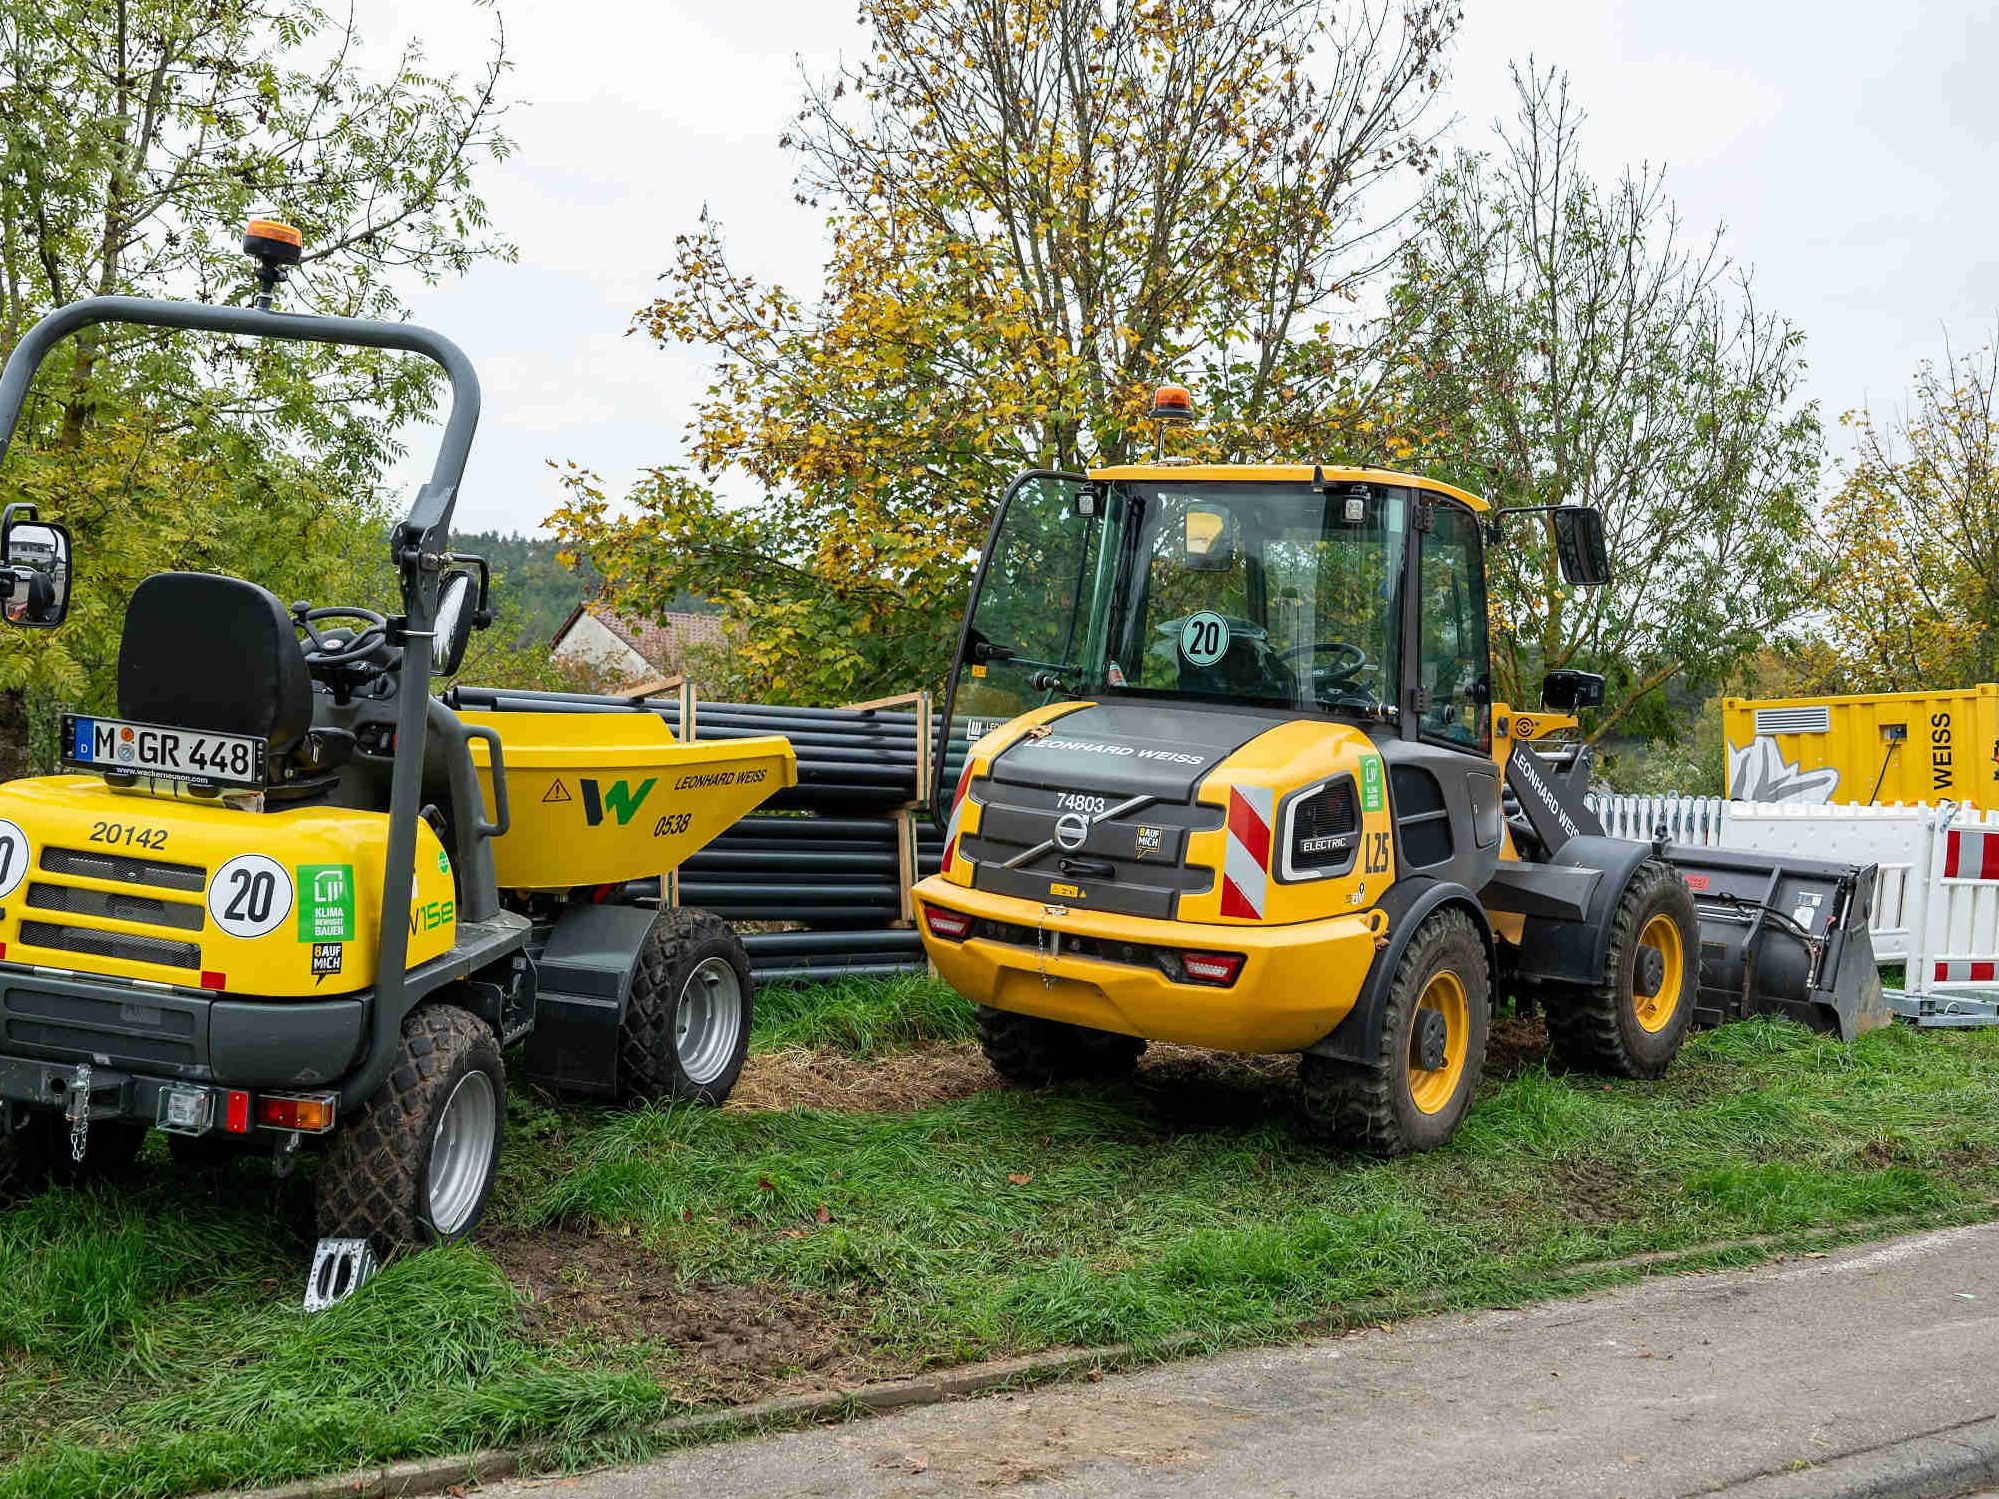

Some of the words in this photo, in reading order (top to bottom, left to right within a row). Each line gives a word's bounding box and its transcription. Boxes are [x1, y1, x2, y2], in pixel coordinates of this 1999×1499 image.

[1189, 620, 1219, 655] 20
[80, 744, 88, 753] D
[94, 725, 115, 759] M
[138, 731, 180, 767] GR
[189, 739, 250, 775] 448
[1023, 738, 1134, 757] LEONHARD
[1138, 749, 1205, 765] WEISS
[1931, 712, 1953, 790] WEISS
[674, 771, 735, 791] LEONHARD
[735, 769, 767, 785] WEISS
[1512, 747, 1559, 815] LEONHARD
[1558, 808, 1580, 838] WEIS
[1057, 793, 1105, 813] 74803
[89, 821, 168, 850] 20142
[653, 812, 692, 838] 0538
[1138, 837, 1159, 847] MICH
[1303, 838, 1346, 851] ELECTRIC
[1365, 831, 1390, 874] L25
[0, 835, 14, 885] 0
[223, 868, 275, 923] 20
[315, 907, 343, 917] KLIMA
[315, 925, 343, 935] BAUEN
[314, 957, 341, 970] MICH
